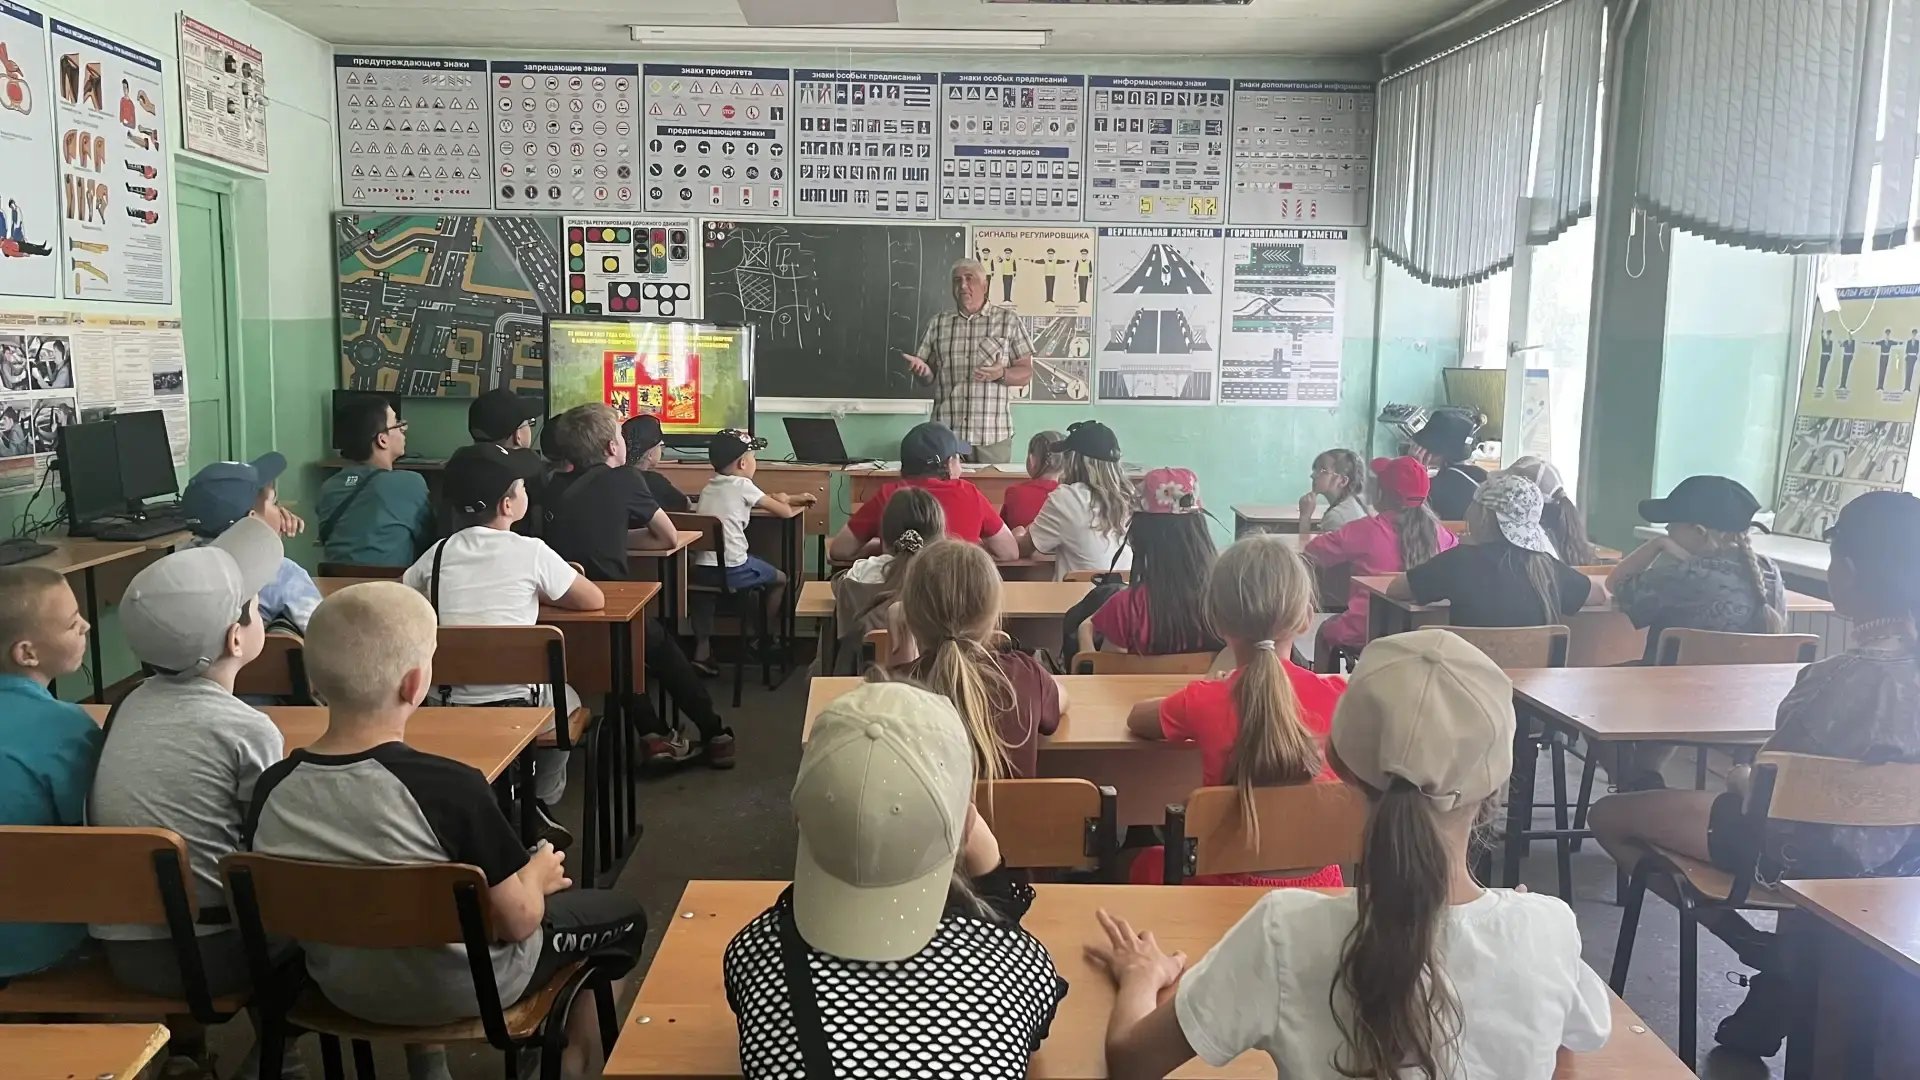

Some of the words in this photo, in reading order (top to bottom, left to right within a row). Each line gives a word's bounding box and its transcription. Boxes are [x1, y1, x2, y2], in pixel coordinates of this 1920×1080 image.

[353, 58, 441, 67] предупреждающие
[523, 64, 582, 73] запрещающие
[705, 69, 753, 77] приоритета
[835, 72, 867, 80] особых
[868, 74, 922, 82] предписаний
[1015, 76, 1068, 84] предписаний
[1112, 78, 1183, 87] информационные
[1260, 82, 1323, 90] дополнительной
[1113, 93, 1123, 101] 50
[667, 127, 741, 136] предписывающие
[1020, 231, 1090, 240] РЕГУЛИРОВЩИКА
[1107, 228, 1168, 237] ВЕРТИКАЛЬНАЯ
[1171, 229, 1214, 238] РАЗМЕТКА
[1230, 229, 1299, 238] ГОРИЗОНТАЛЬНАЯ
[1301, 230, 1343, 239] РАЗМЕТКА
